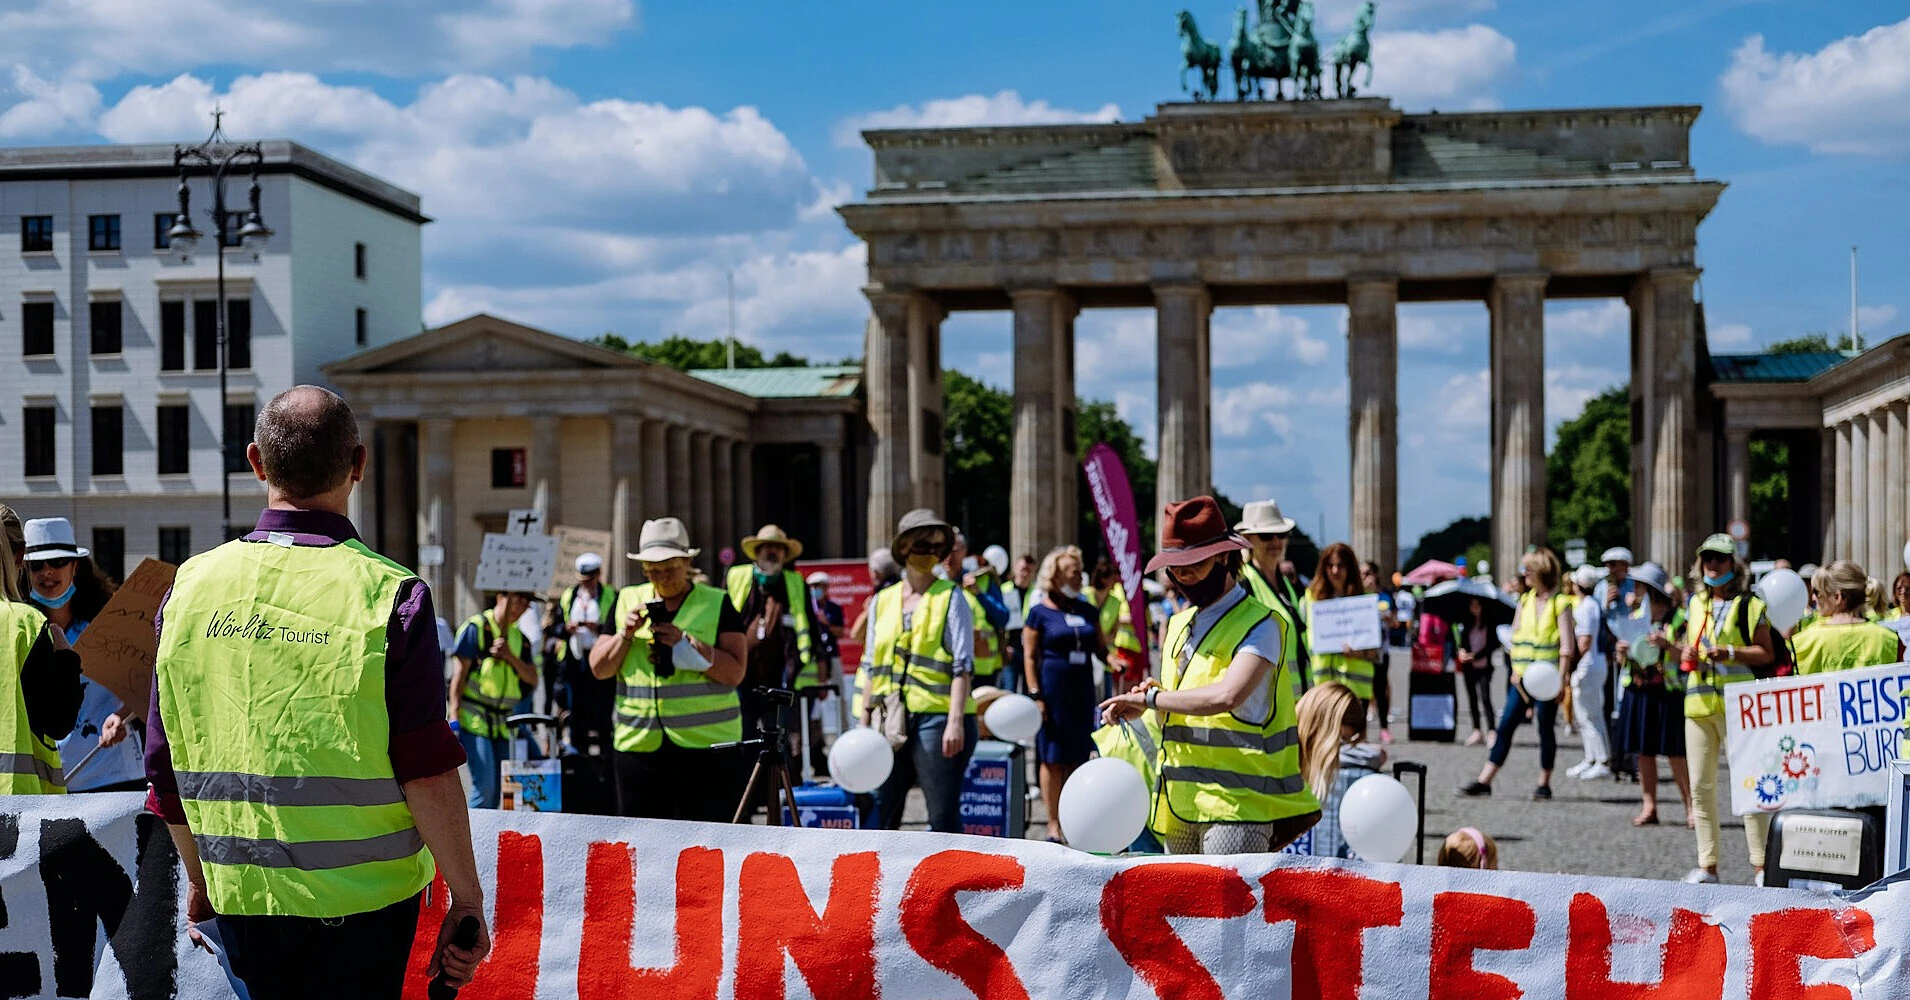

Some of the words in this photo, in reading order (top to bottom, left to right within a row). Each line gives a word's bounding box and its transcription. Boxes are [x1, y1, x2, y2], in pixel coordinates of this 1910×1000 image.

[206, 610, 275, 639] Wörlitz
[279, 626, 330, 645] Tourist
[1739, 684, 1825, 730] RETTET
[960, 803, 1002, 817] CHIRM
[577, 840, 1029, 1000] UNS
